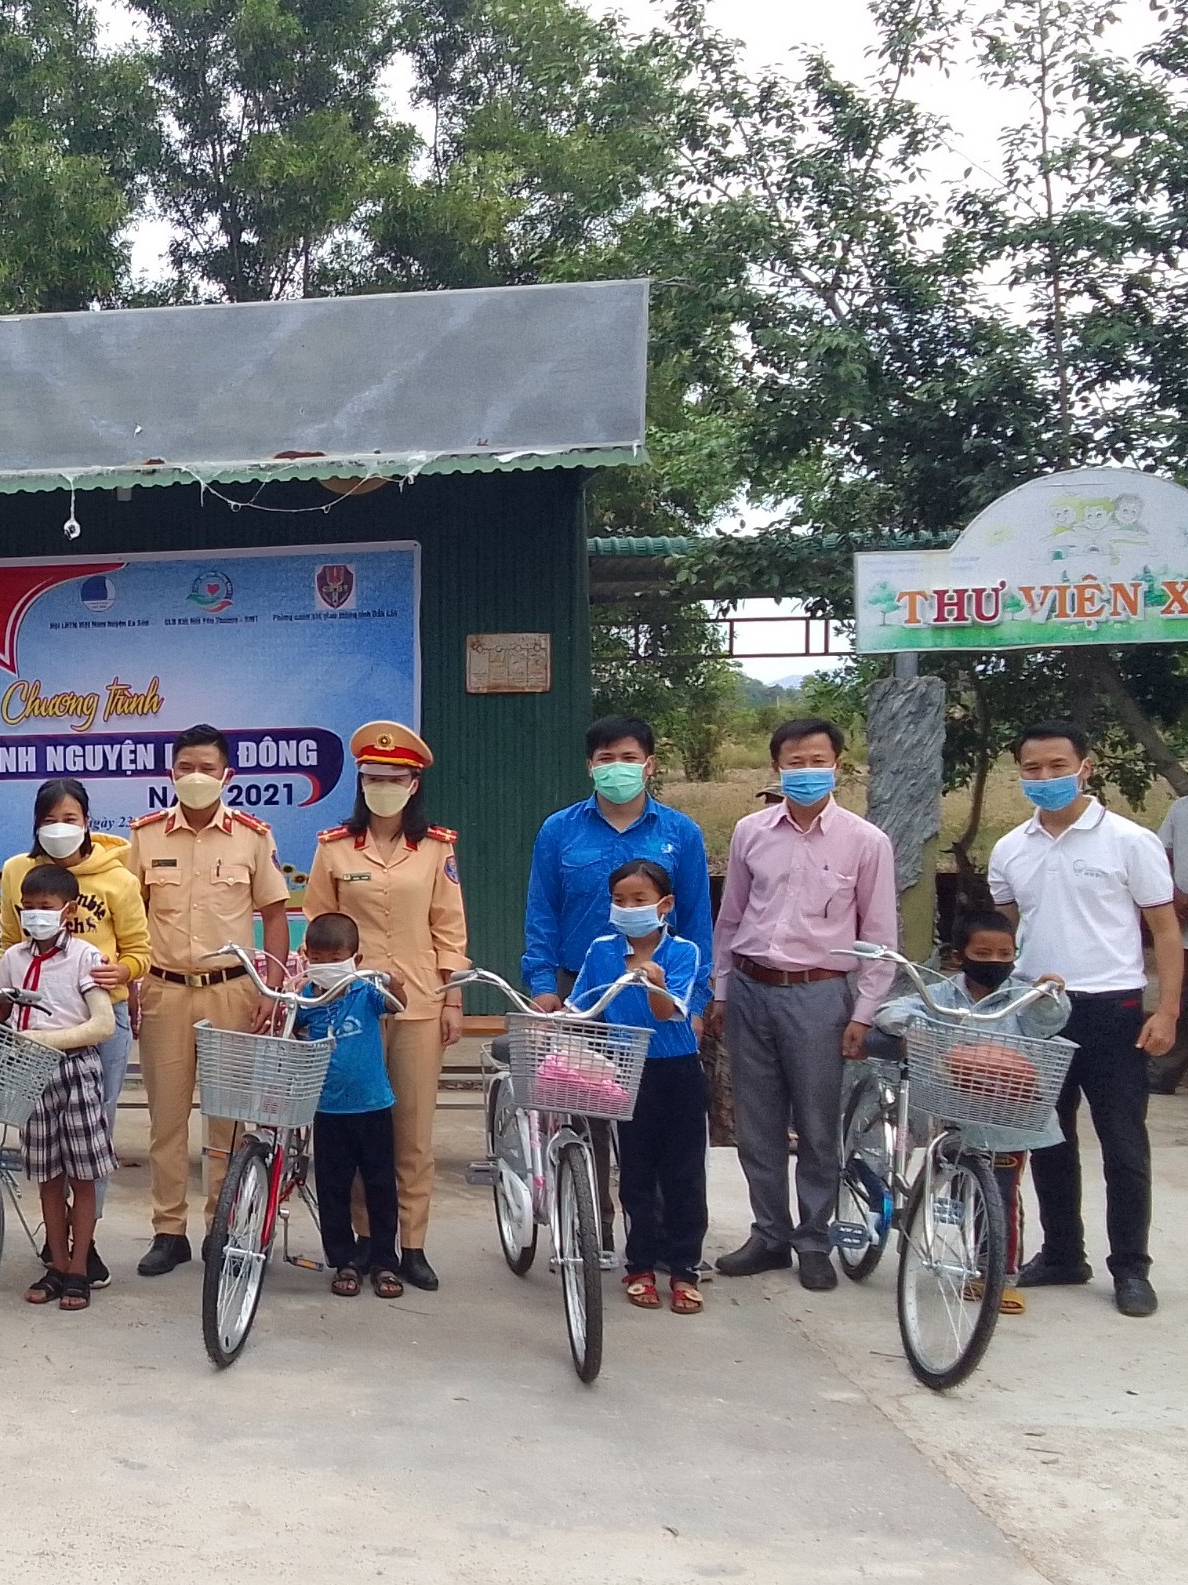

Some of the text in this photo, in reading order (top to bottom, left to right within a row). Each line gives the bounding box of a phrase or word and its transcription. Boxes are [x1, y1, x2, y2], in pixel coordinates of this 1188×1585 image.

[896, 579, 1007, 625] THƯ
[1017, 573, 1143, 629] VIỆN
[1, 676, 164, 732] Chương trình
[46, 739, 155, 775] NGUYỆN
[237, 736, 318, 768] ĐÔNG
[227, 783, 293, 807] 2021
